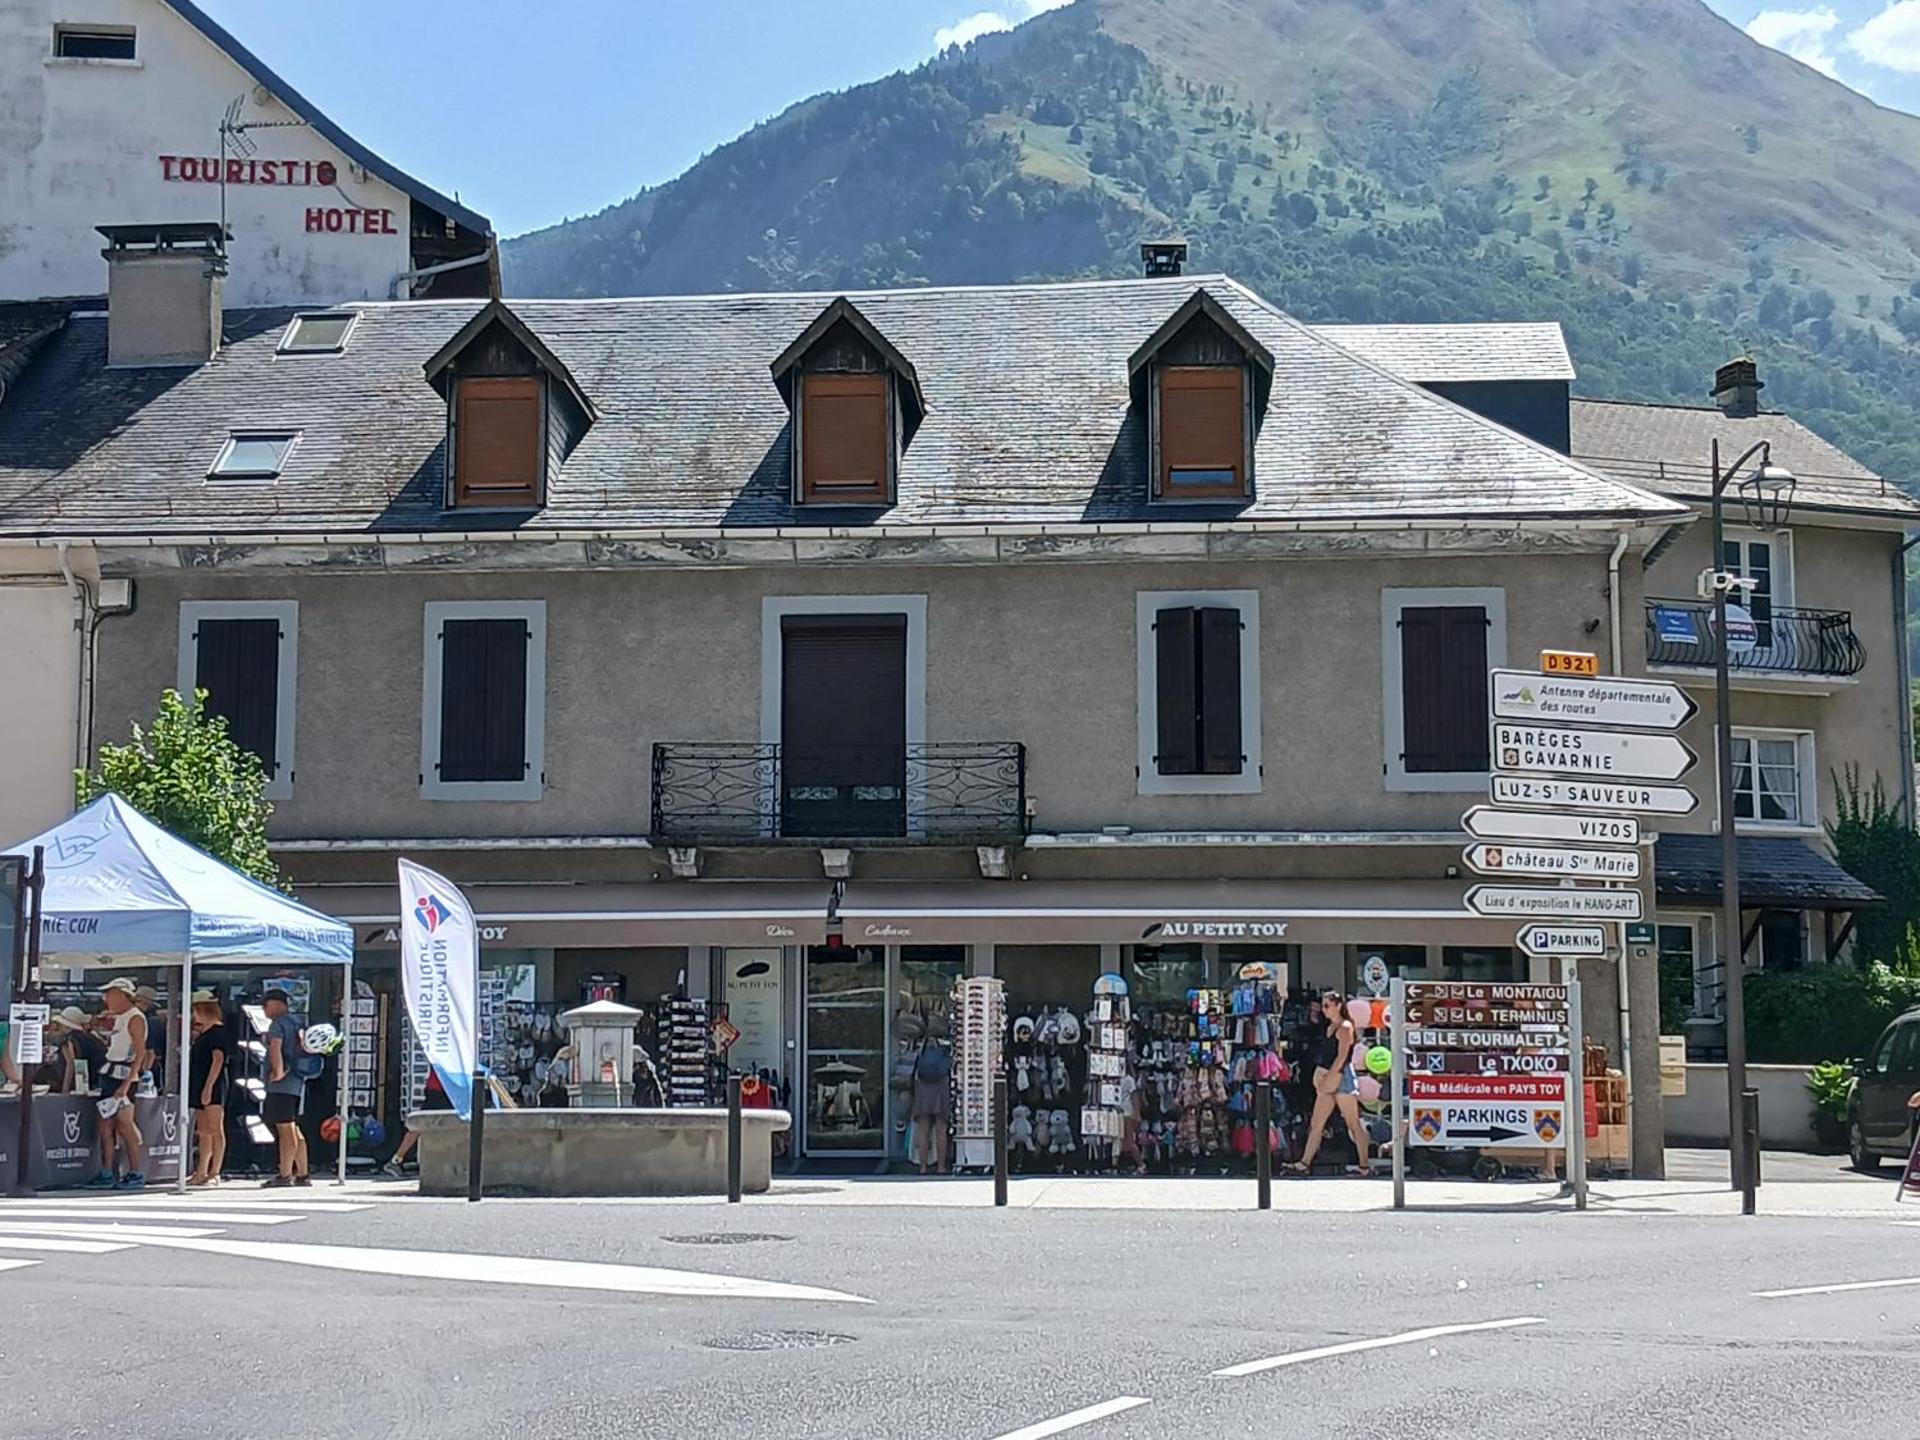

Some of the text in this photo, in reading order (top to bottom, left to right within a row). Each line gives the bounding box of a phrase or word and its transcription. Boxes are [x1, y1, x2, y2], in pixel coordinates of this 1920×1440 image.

[306, 208, 397, 234] HOTEL
[1540, 685, 1671, 704] Antenne départementale
[1540, 700, 1596, 714] des routes
[1502, 730, 1582, 749] BARÈGES
[1525, 751, 1612, 769] GAVARNIE
[1568, 787, 1650, 805] SAUVEUR
[1580, 822, 1632, 838] VIZOS
[1506, 852, 1634, 872] château Ste Marie
[1485, 895, 1505, 907] Lieu
[1572, 897, 1581, 908] le
[42, 917, 99, 934] NIE.COM
[1161, 922, 1288, 936] AU PETIT TOY
[384, 927, 508, 942] A OY
[1550, 933, 1600, 946] PARKING
[1467, 986, 1566, 999] Le MONTAIGU
[1466, 1009, 1566, 1023] Le TERMINUS
[1439, 1032, 1553, 1046] LE TOURMALET
[1479, 1055, 1557, 1071] Le TXOKO
[1412, 1081, 1561, 1094] Fête Médiévale en PAYS TOY
[1448, 1109, 1527, 1123] PARKINGS
